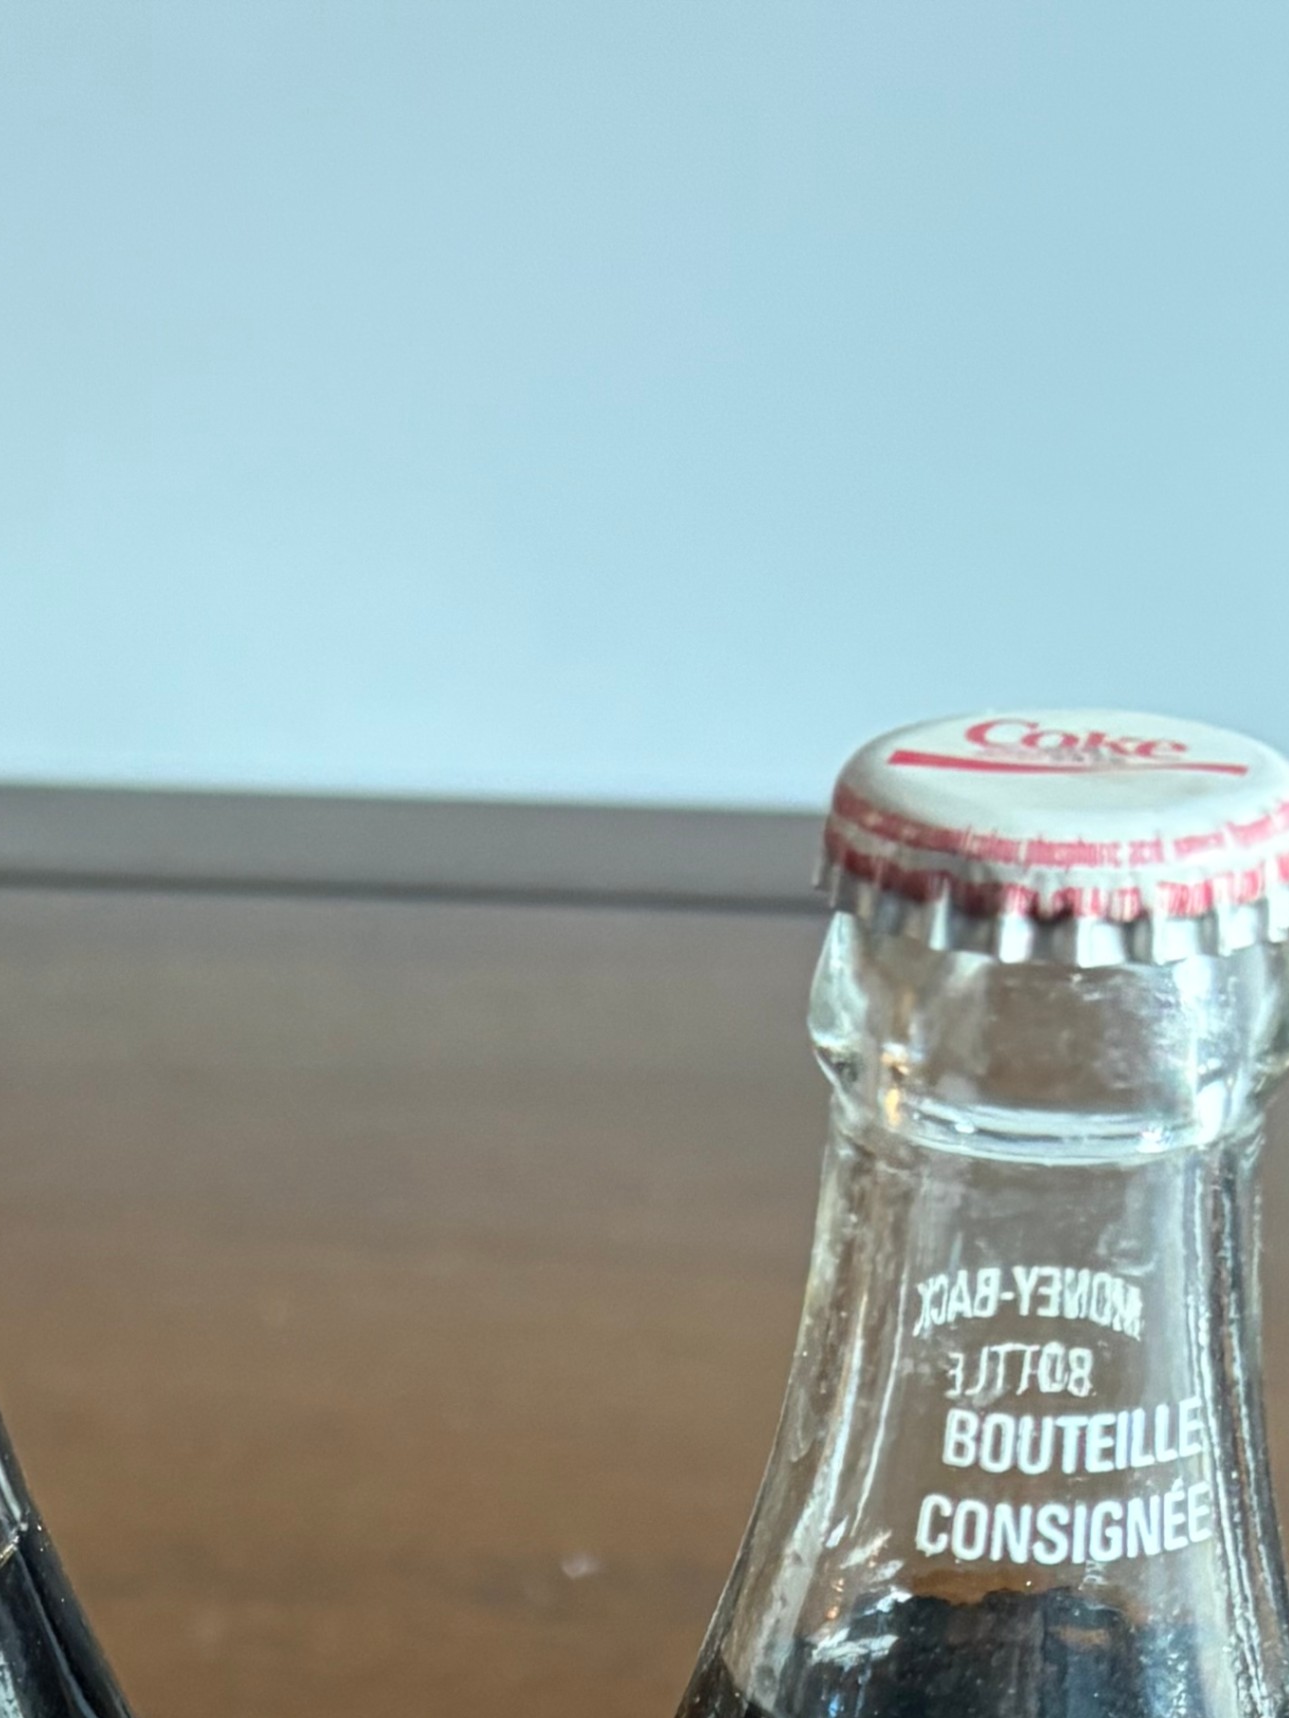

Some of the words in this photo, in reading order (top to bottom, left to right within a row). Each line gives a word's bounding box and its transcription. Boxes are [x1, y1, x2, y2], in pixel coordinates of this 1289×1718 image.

[964, 717, 1189, 757] Coke
[942, 1397, 1208, 1475] BOUTEILLE
[915, 1477, 1215, 1565] CONSIGNÉE
